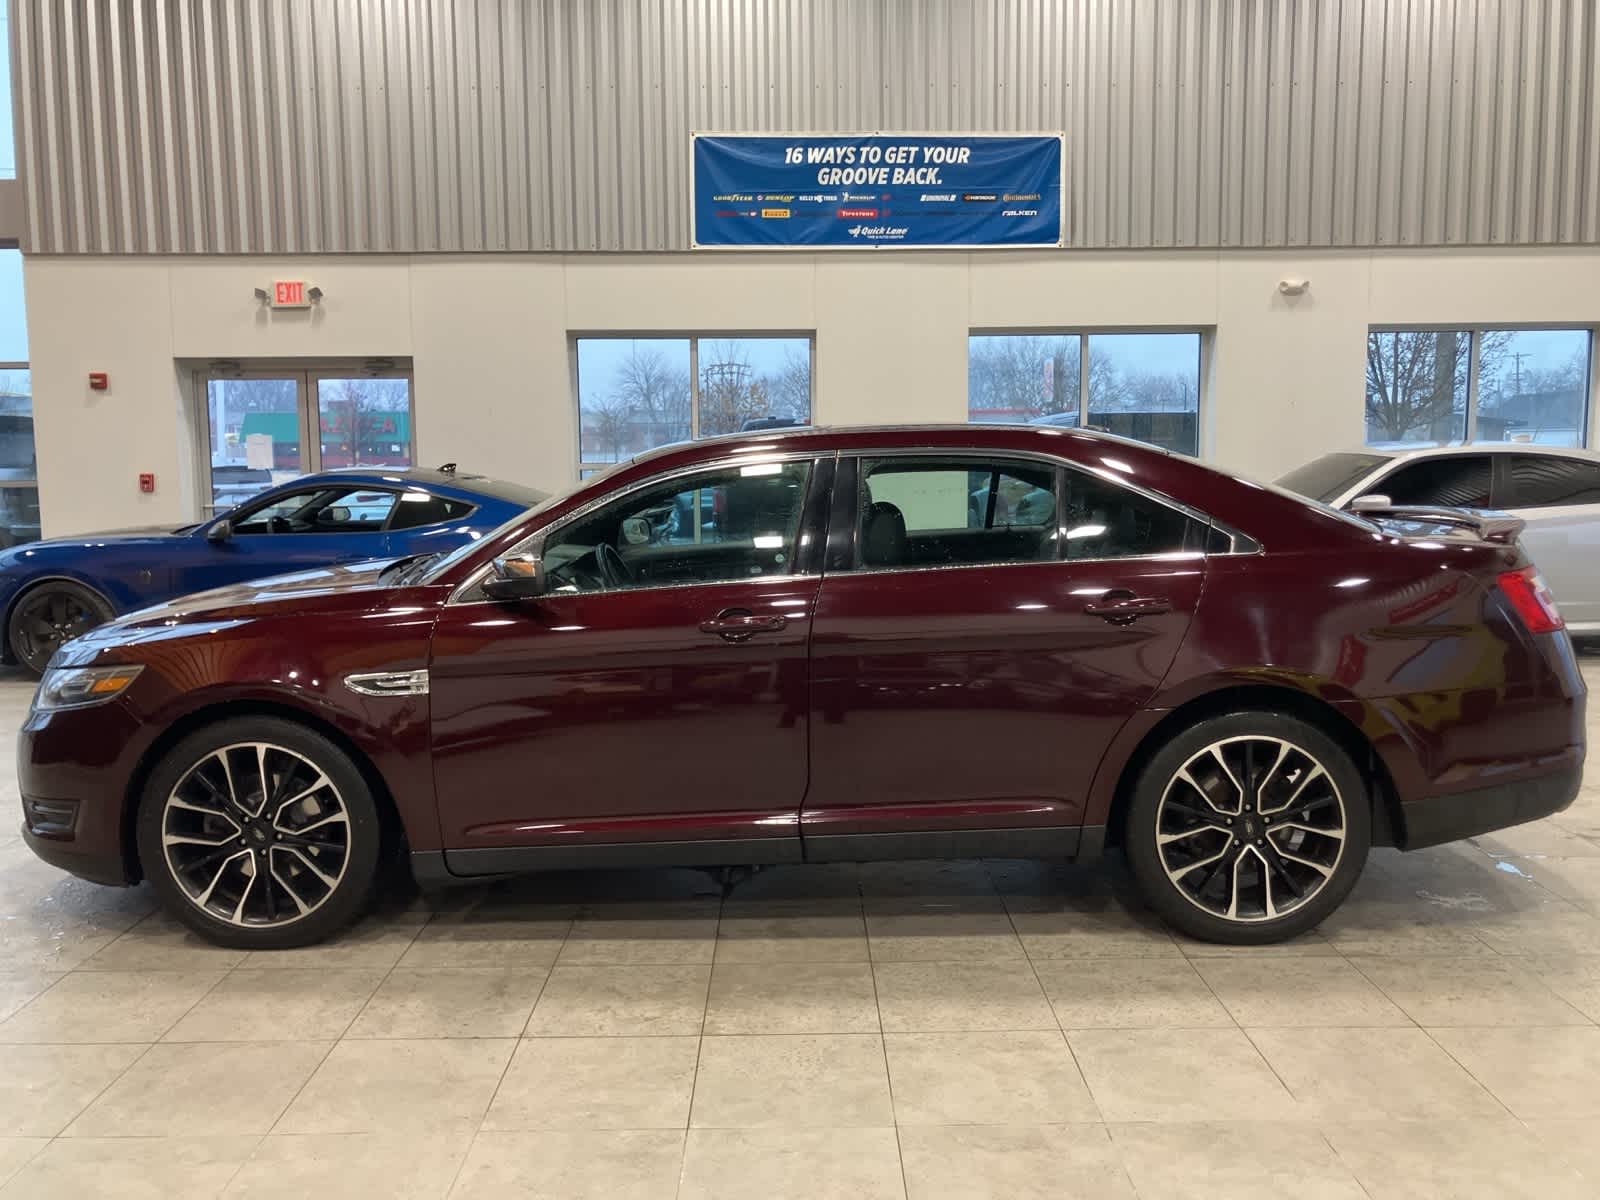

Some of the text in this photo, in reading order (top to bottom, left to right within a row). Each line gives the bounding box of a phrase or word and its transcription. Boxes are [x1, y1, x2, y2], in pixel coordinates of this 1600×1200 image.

[785, 147, 971, 164] 16 WAYS TO GET YOUR
[817, 167, 943, 185] GROOVE BACK.
[861, 226, 909, 235] Quick Lane
[275, 281, 304, 304] EXIT
